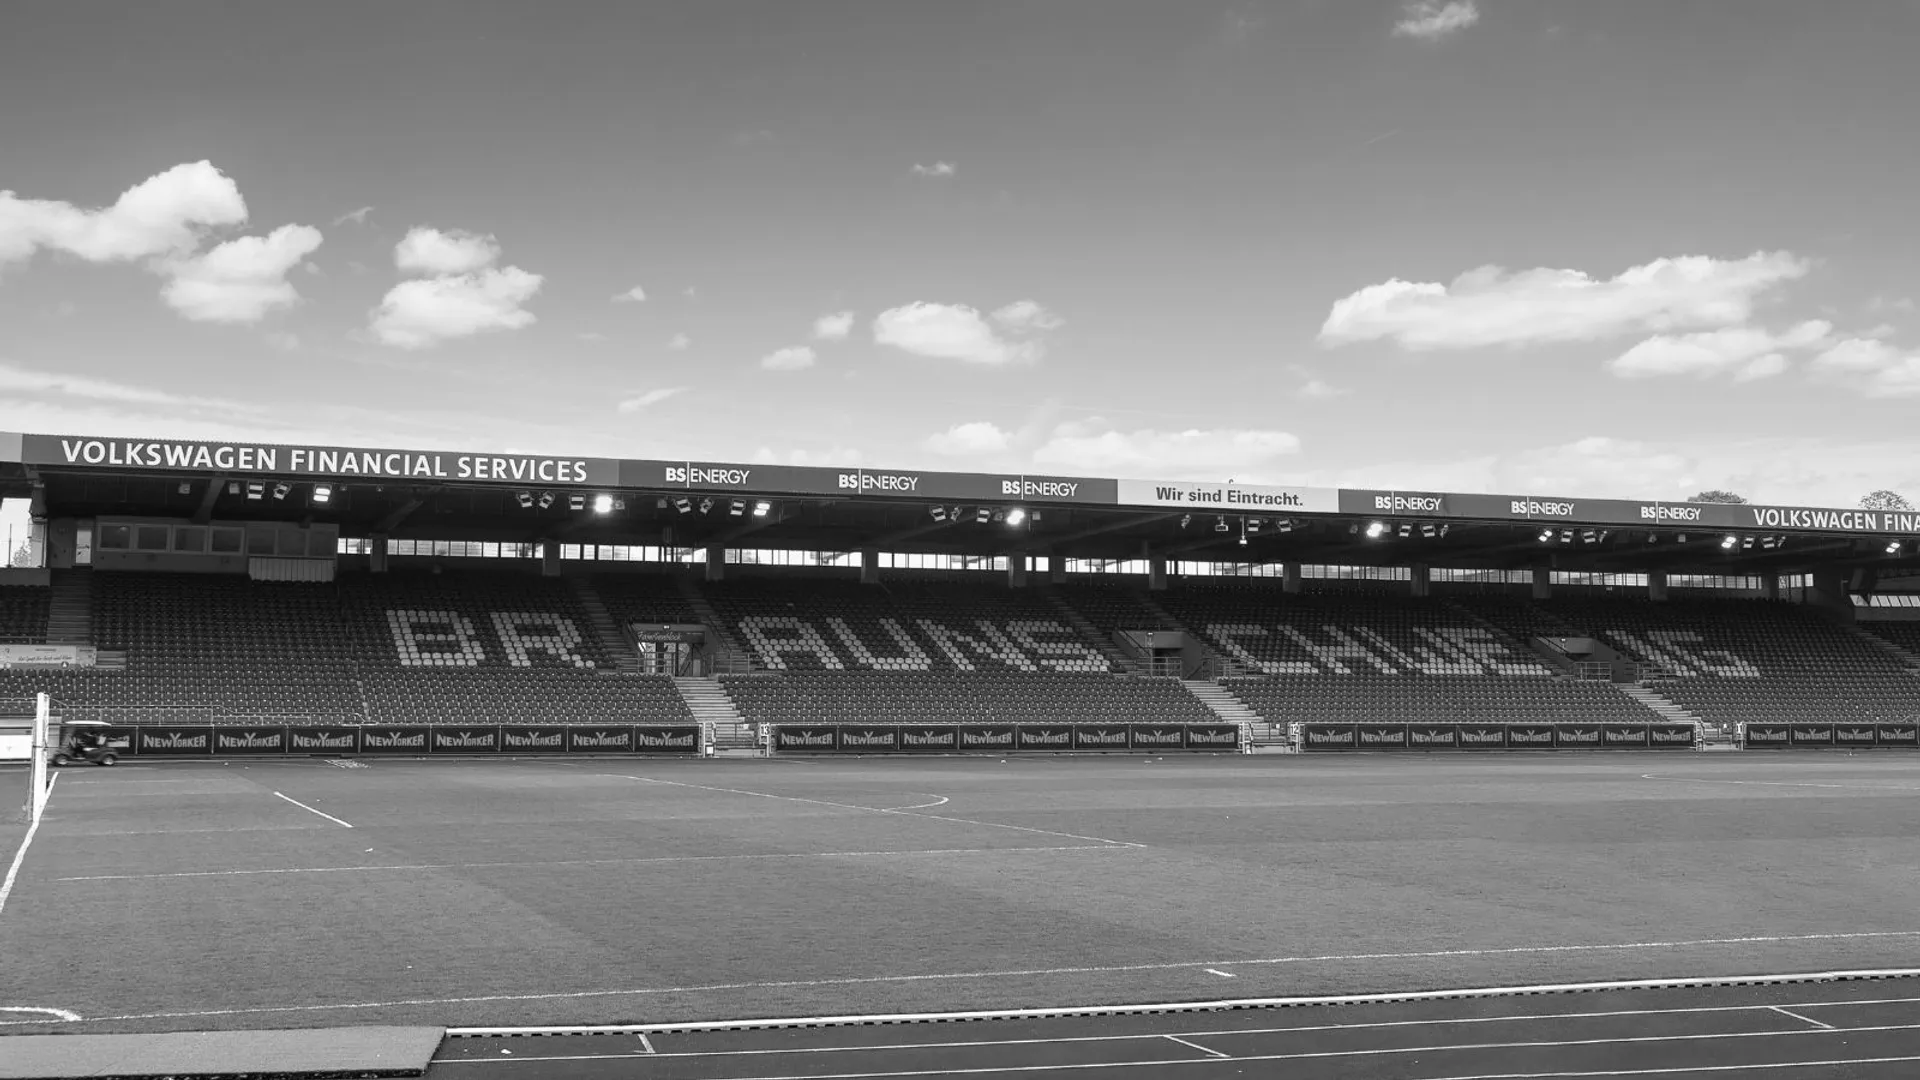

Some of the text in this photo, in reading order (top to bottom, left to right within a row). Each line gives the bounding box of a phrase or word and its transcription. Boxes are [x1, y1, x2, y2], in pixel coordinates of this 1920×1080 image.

[62, 440, 588, 483] VOLKSWAGEN FINANCIAL SERVICES
[1156, 487, 1304, 506] Wir sind Eintracht.
[1753, 508, 1877, 530] VOLKSWAGEN
